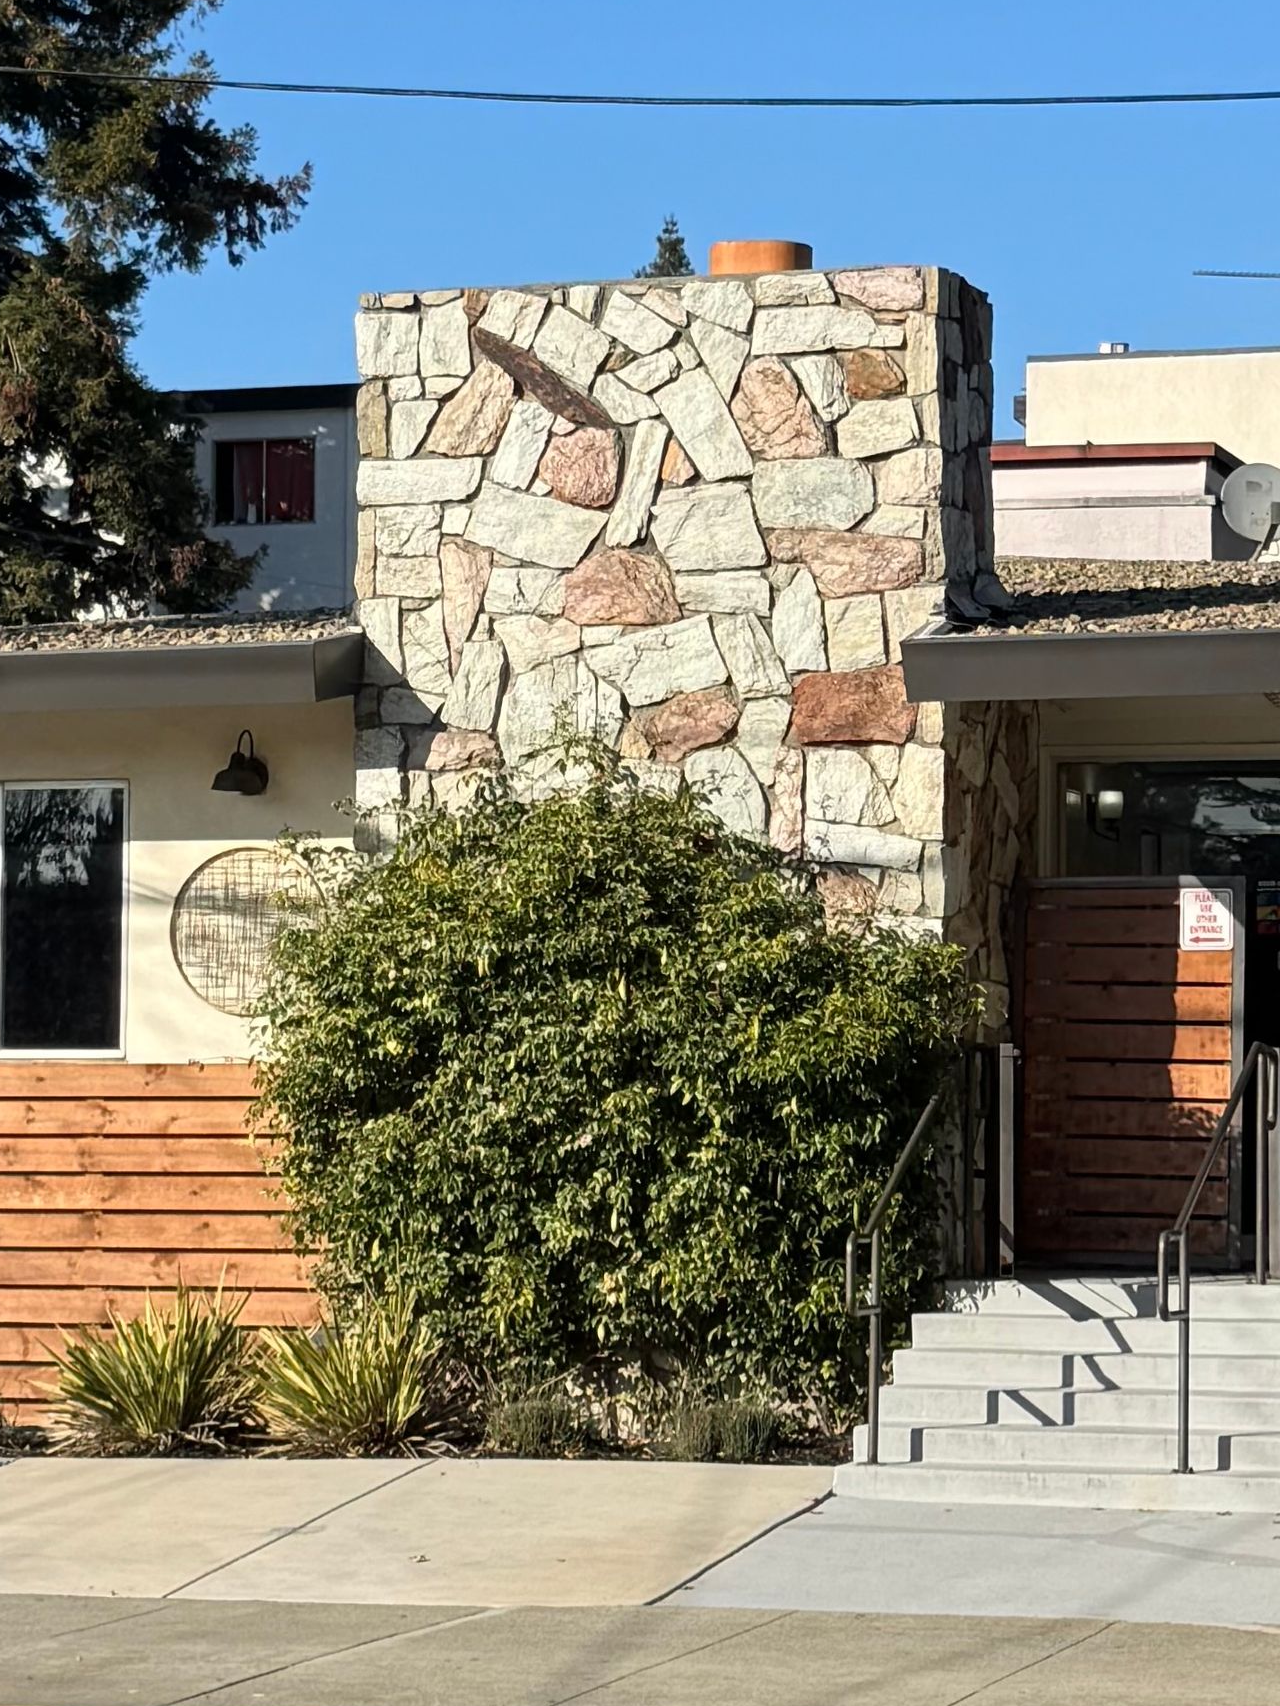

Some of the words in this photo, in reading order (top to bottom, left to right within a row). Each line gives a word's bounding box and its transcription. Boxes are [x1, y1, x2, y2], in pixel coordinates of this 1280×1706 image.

[1200, 903, 1213, 913] USE
[1196, 915, 1218, 923] OTHER
[1190, 925, 1223, 934] ENTRANCE
